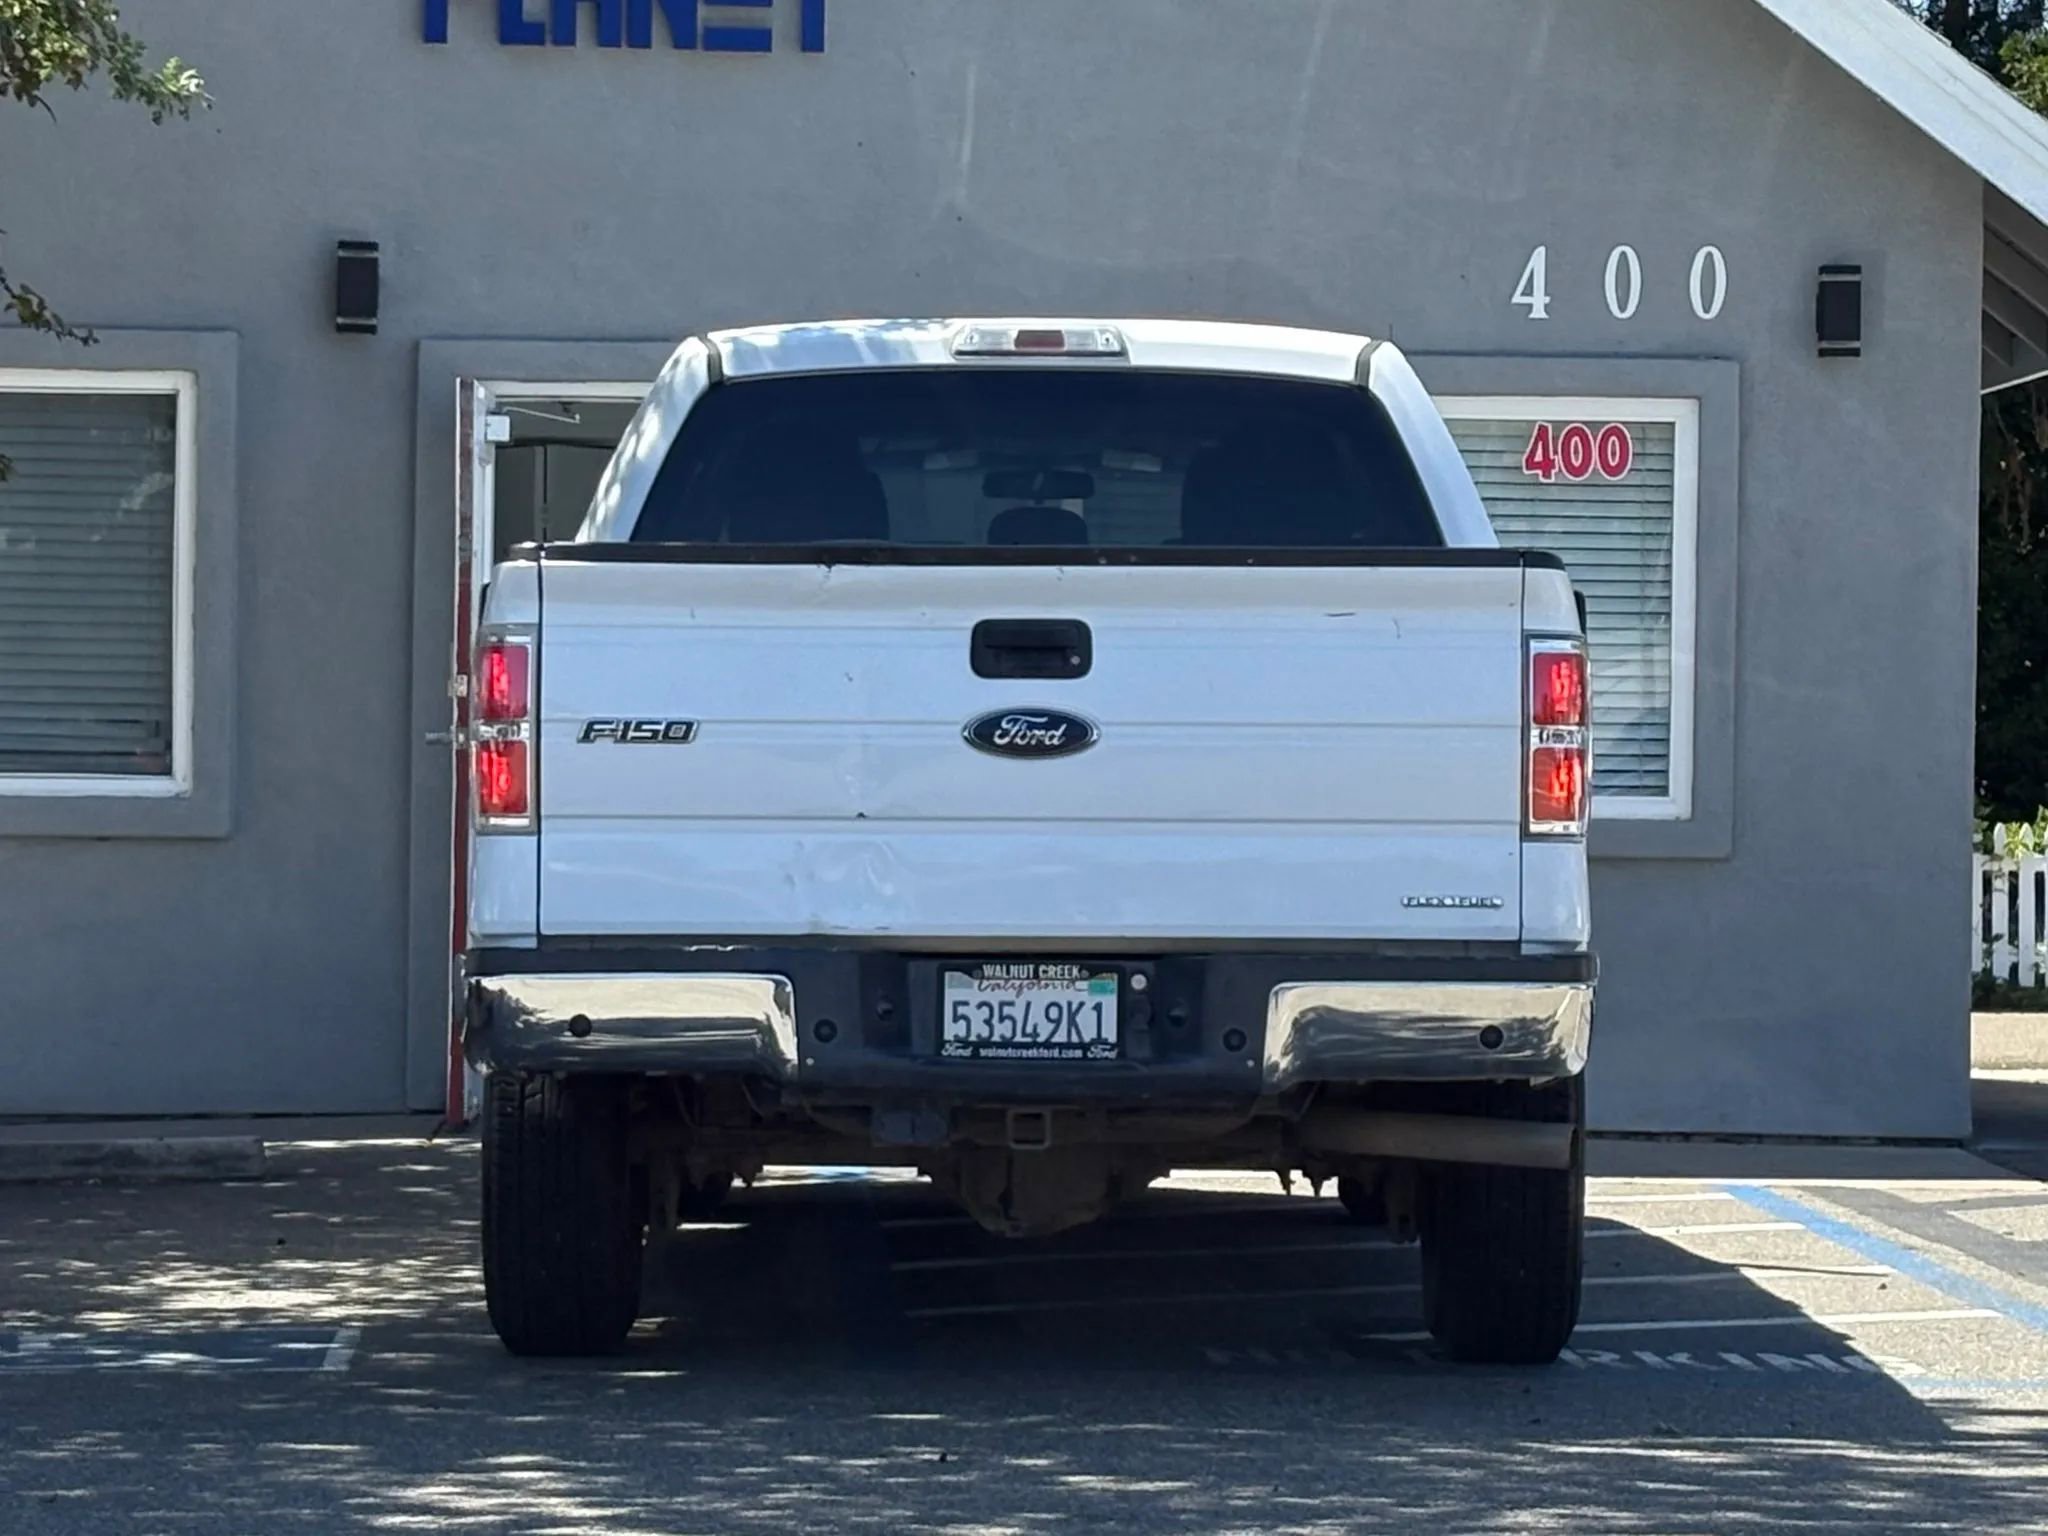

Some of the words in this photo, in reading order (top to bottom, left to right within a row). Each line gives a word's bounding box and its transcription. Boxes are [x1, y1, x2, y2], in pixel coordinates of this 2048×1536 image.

[1511, 245, 1727, 319] 400
[1522, 421, 1632, 482] 400
[993, 715, 1067, 745] Ford
[982, 964, 1035, 979] WALNUT
[1039, 964, 1080, 979] CREEK
[977, 977, 1082, 998] California
[952, 1001, 1109, 1043] 53549K1
[941, 1042, 973, 1057] Ford
[1087, 1044, 1119, 1059] Ford
[1558, 1346, 1927, 1374] RKING
